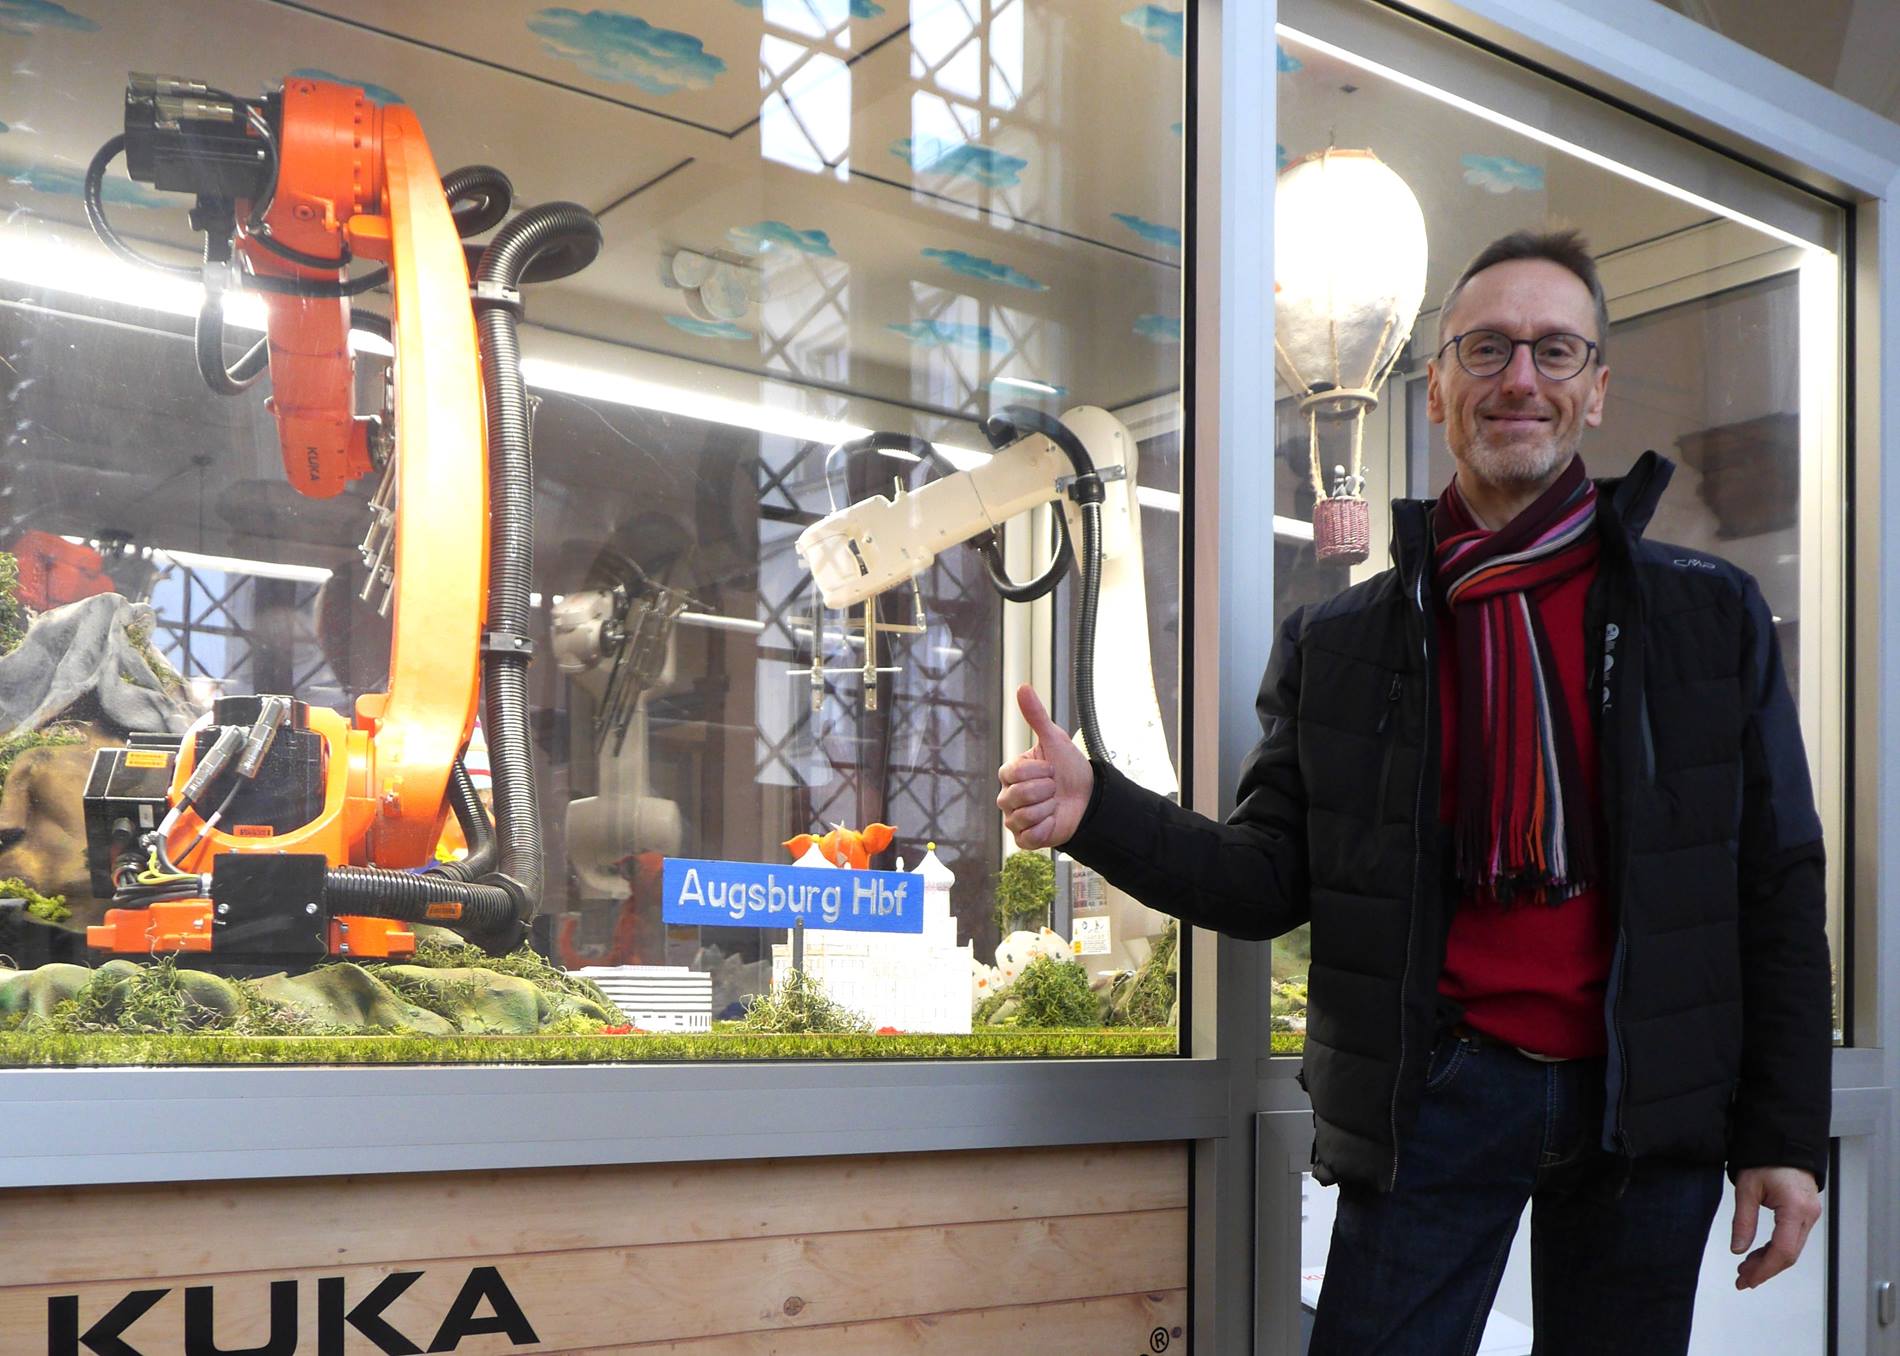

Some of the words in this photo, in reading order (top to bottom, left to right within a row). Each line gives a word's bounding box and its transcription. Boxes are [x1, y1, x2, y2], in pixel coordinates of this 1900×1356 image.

[678, 868, 841, 923] Augsburg
[852, 877, 909, 916] Hbf
[48, 1266, 541, 1356] KUKA
